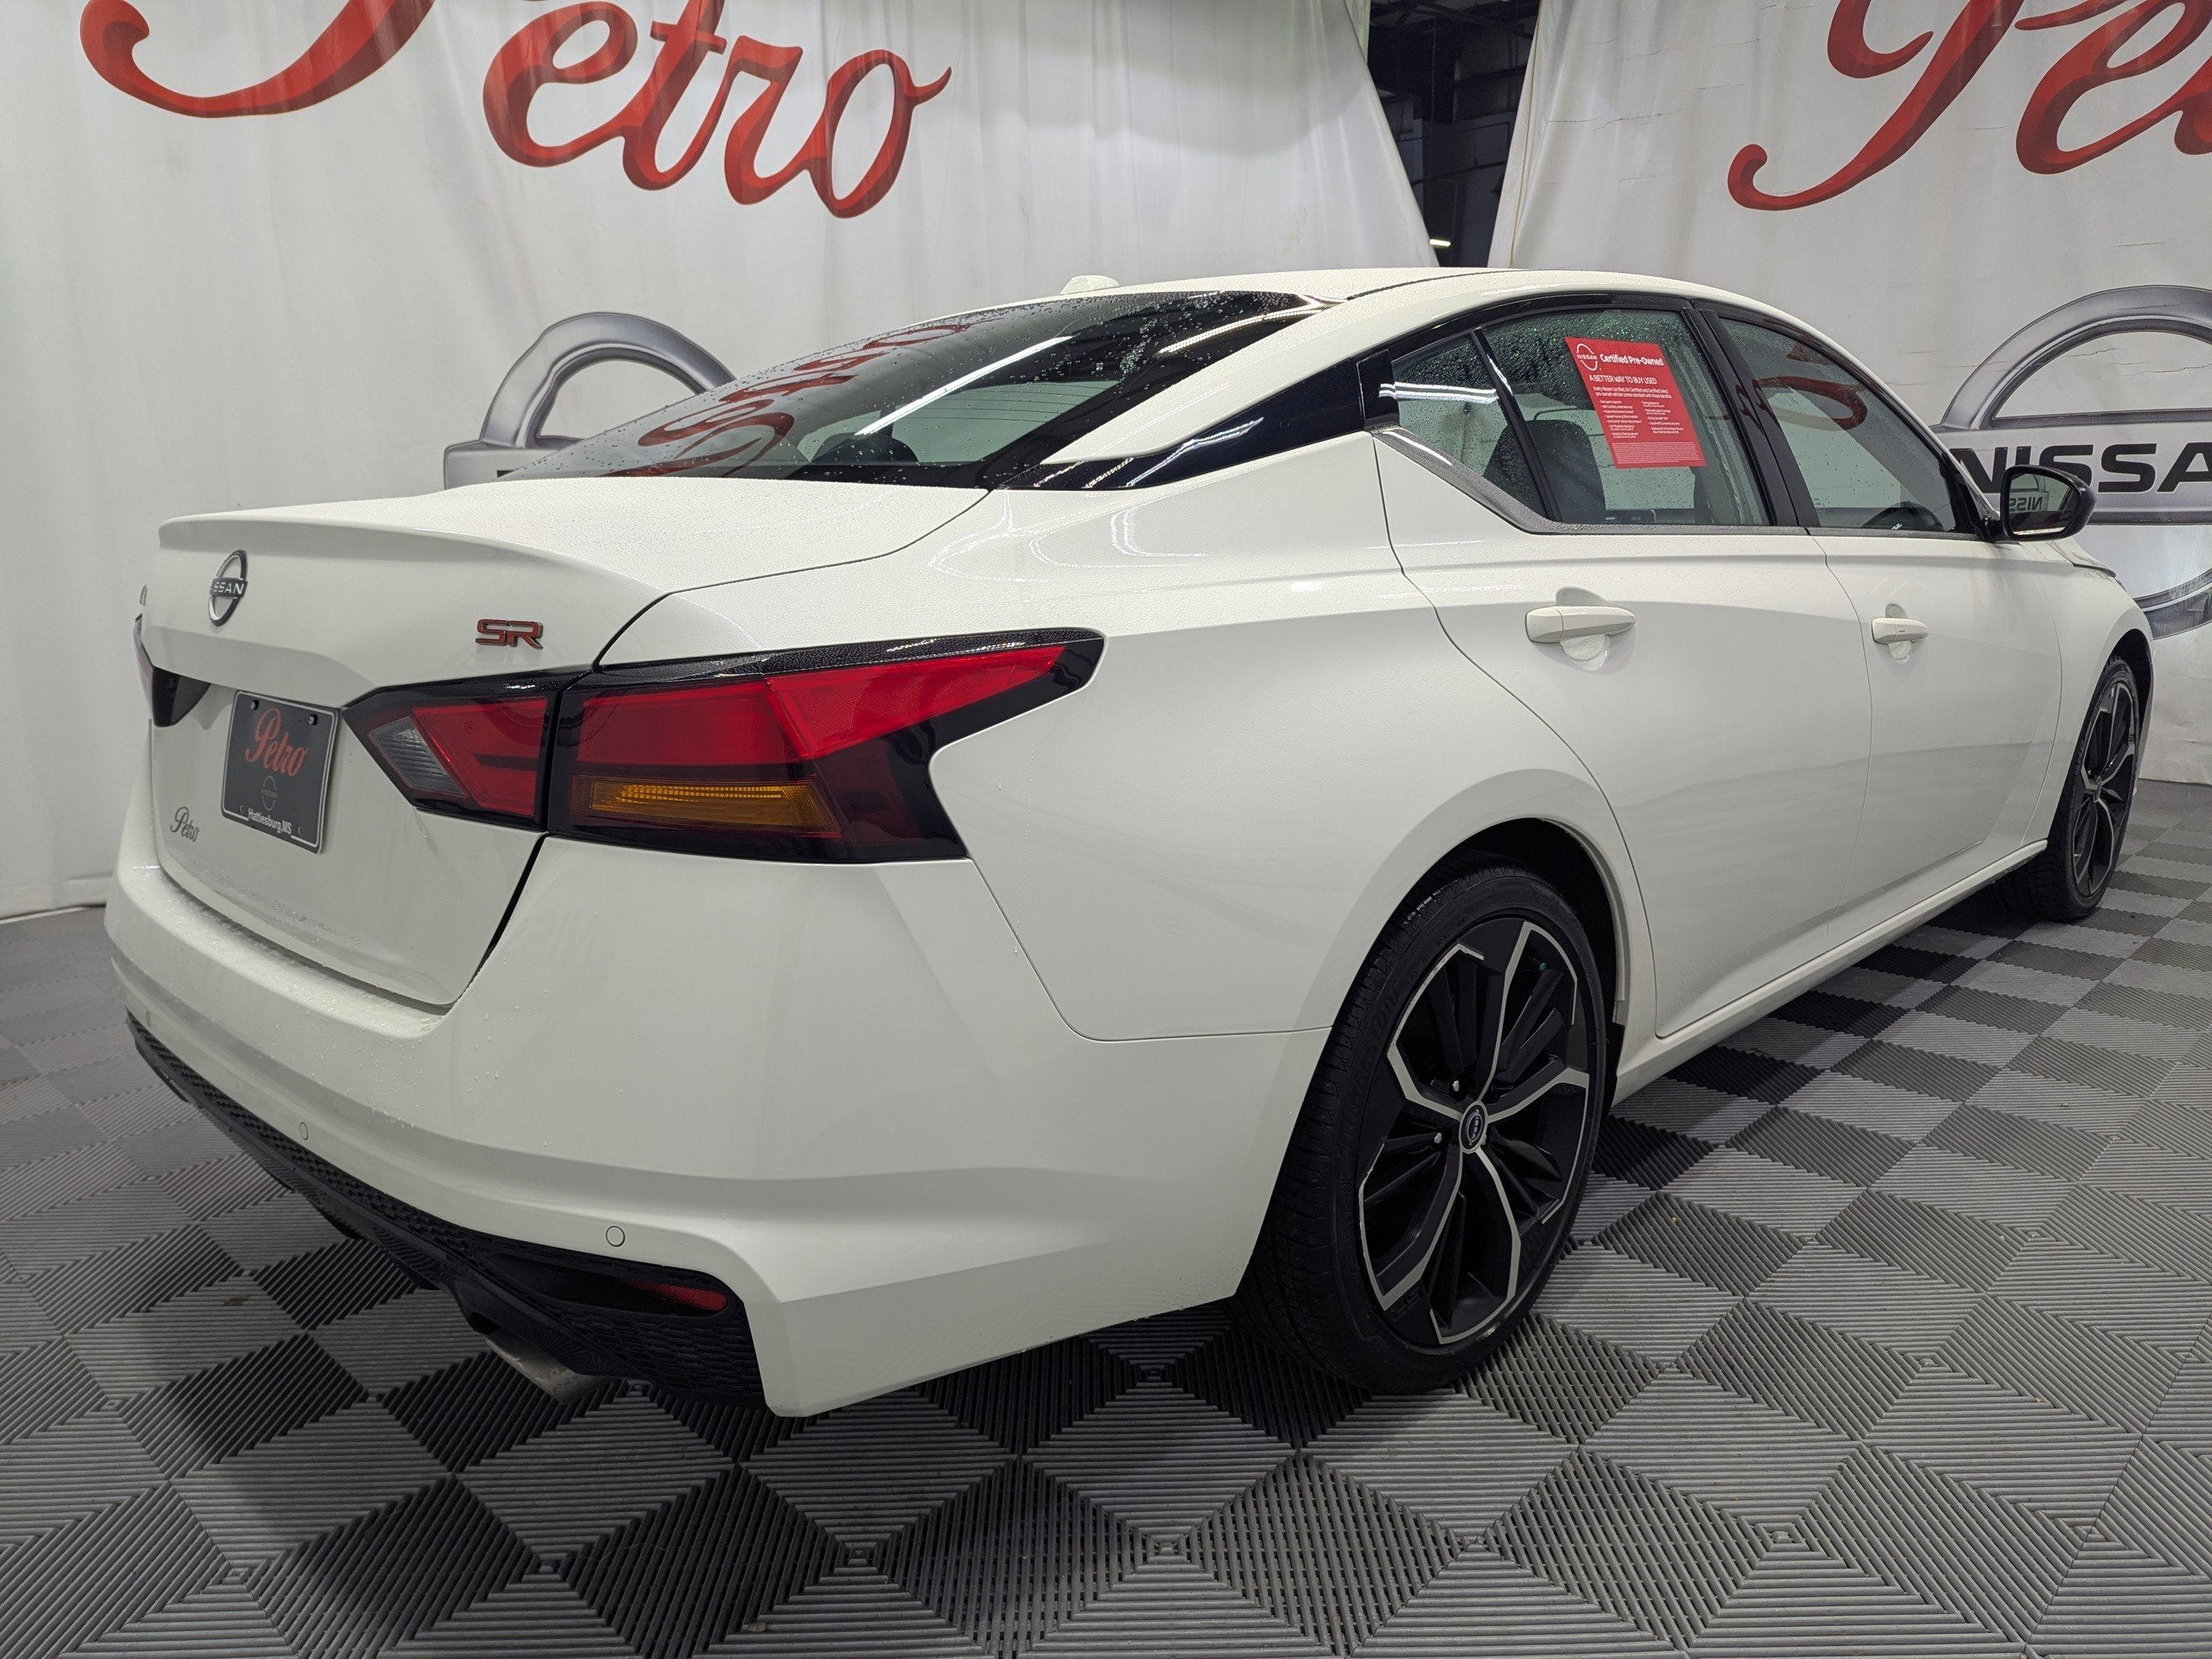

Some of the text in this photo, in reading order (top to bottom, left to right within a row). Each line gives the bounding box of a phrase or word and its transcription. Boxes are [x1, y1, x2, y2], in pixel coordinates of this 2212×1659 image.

[1599, 353, 1664, 365] Certified Pre-Owned
[475, 619, 543, 649] SR
[245, 708, 308, 777] Petro
[170, 806, 200, 842] Petro
